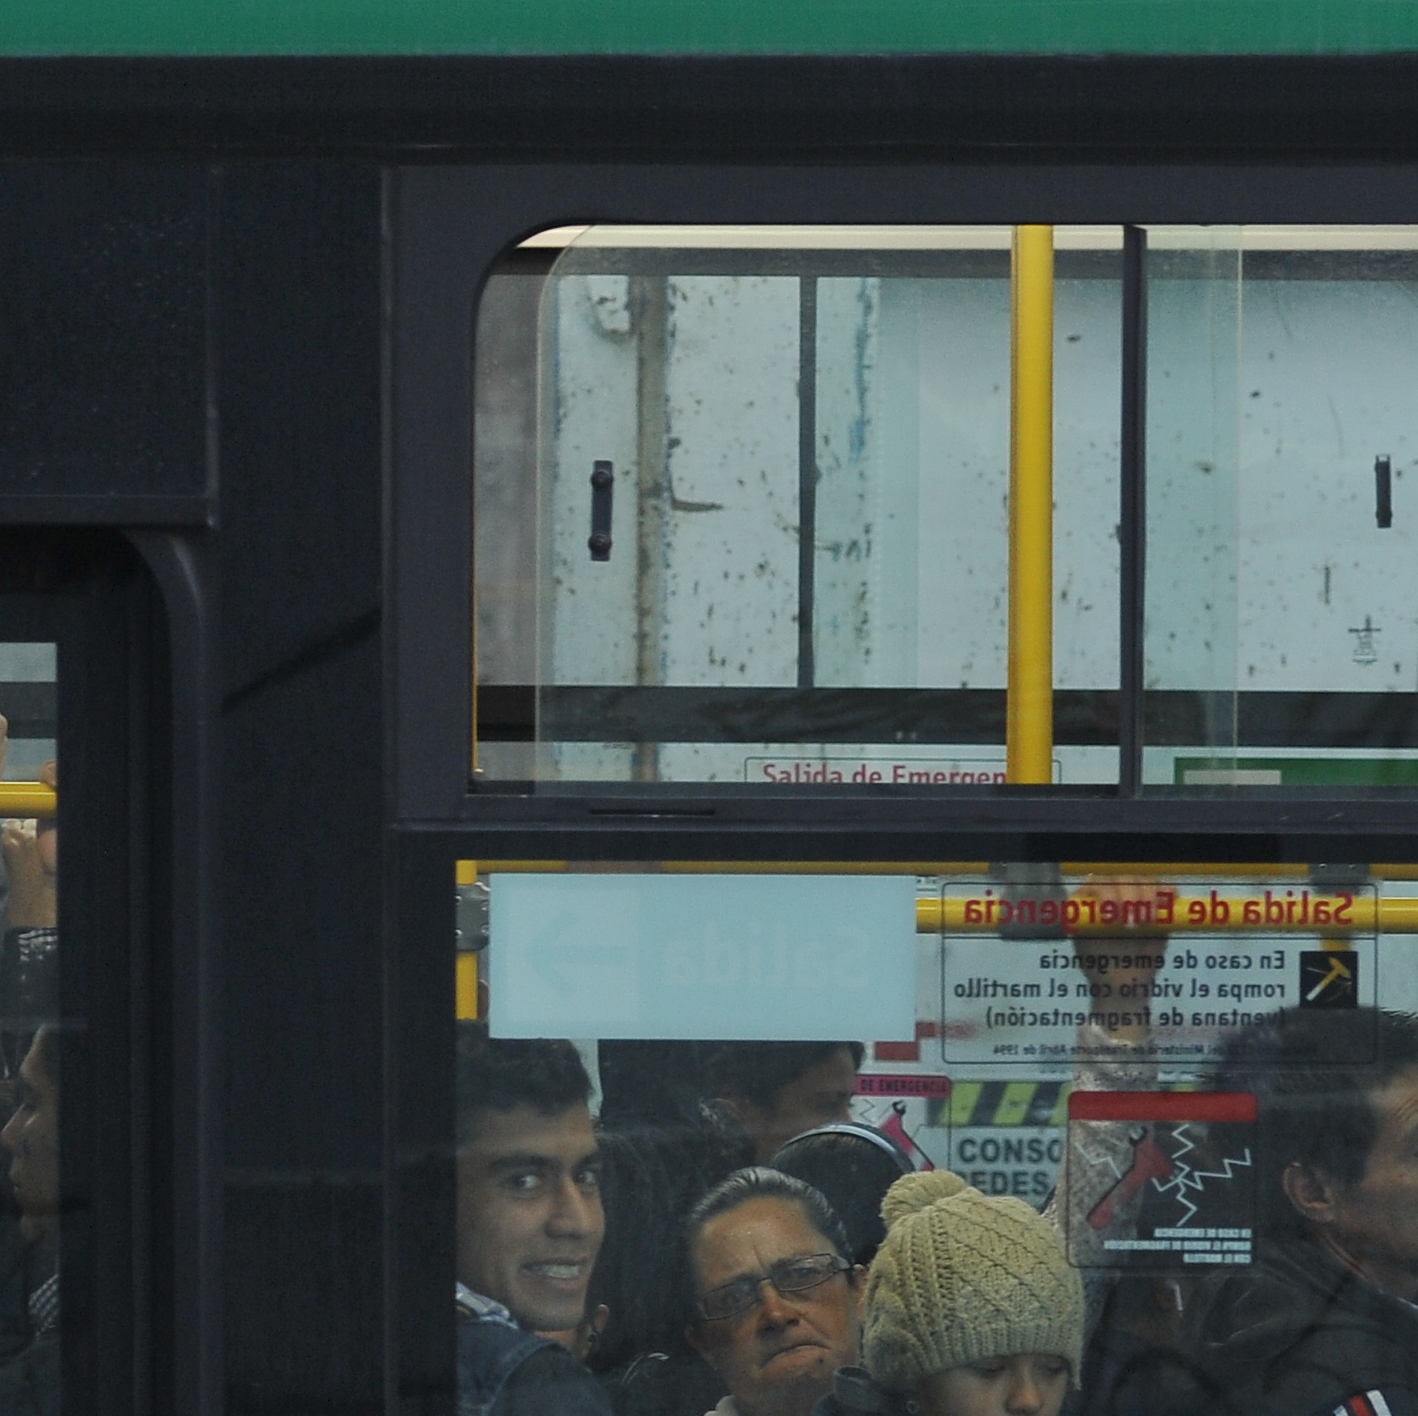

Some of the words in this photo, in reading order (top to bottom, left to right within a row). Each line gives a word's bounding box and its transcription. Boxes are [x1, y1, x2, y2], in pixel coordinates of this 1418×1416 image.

[763, 763, 843, 783] Salida
[852, 764, 882, 783] de
[892, 765, 1007, 784] Emergen
